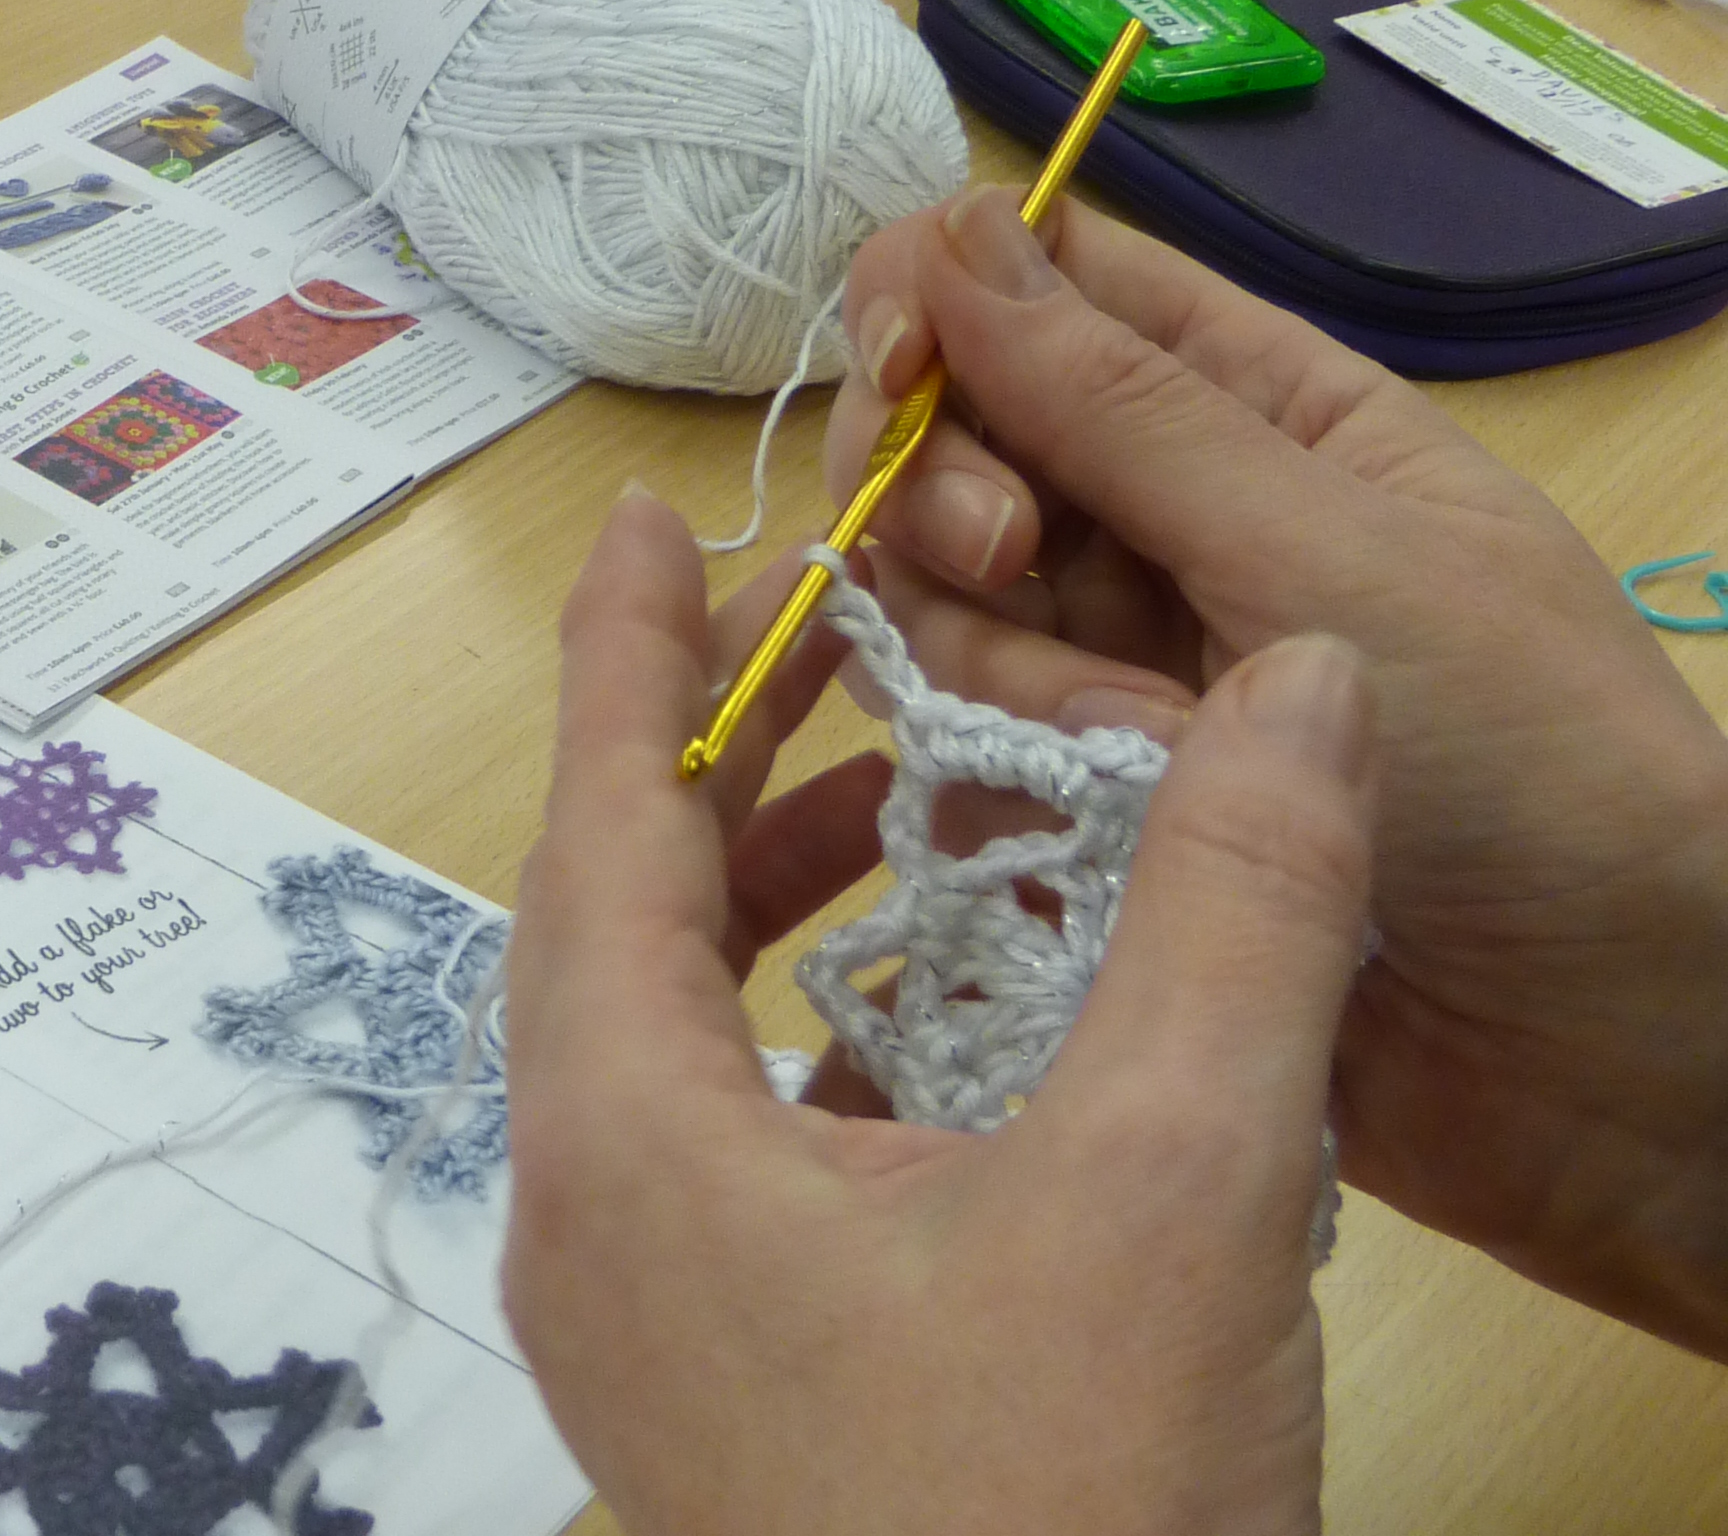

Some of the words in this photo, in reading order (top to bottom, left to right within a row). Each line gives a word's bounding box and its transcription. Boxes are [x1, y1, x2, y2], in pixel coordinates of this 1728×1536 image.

[10, 392, 25, 402] &
[22, 363, 75, 394] Crochet
[23, 398, 65, 425] STEPS
[62, 387, 83, 401] IN
[80, 353, 138, 389] CROCHET
[37, 981, 74, 1002] to
[80, 947, 146, 994] your
[138, 898, 207, 948] tree!
[39, 944, 64, 961] a
[55, 906, 135, 957] flake
[138, 889, 173, 911] or
